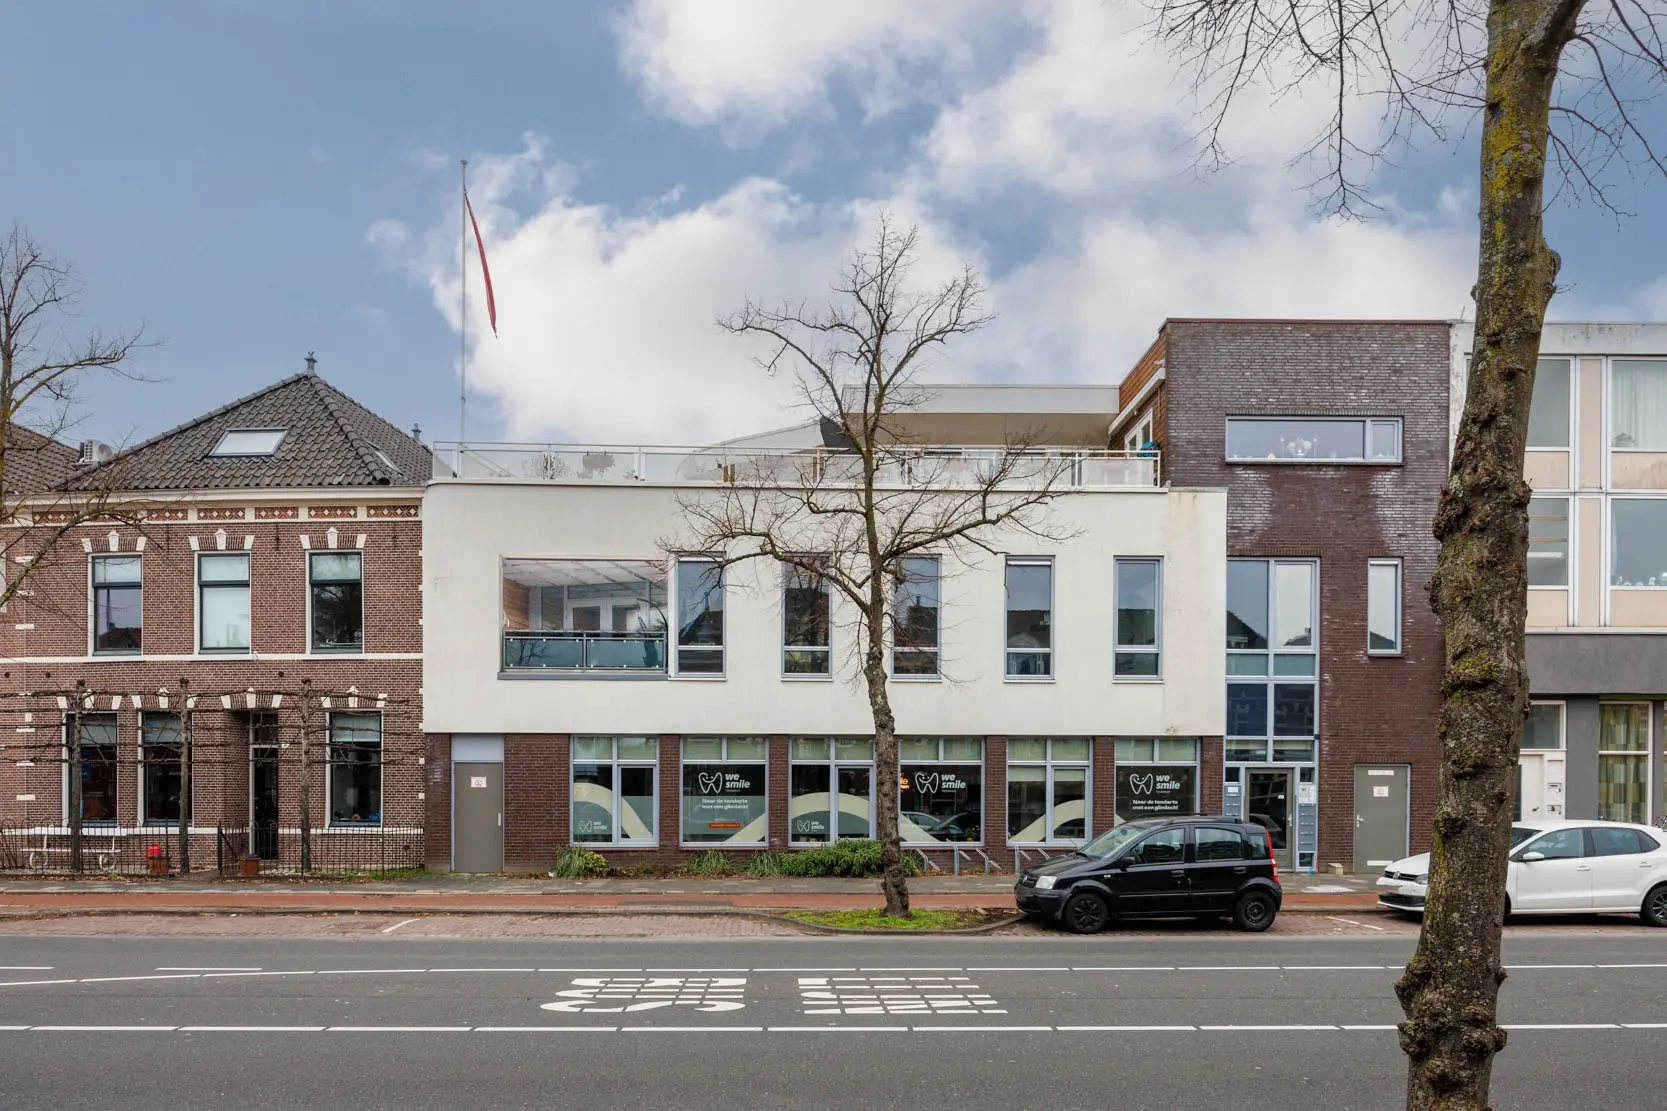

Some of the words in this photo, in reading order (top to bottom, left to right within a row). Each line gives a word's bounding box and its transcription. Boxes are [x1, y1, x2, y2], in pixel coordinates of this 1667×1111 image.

[725, 773, 740, 781] we
[1155, 774, 1170, 782] we
[725, 779, 751, 789] smile
[941, 780, 966, 789] smile
[1155, 780, 1181, 790] smile
[539, 977, 747, 1013] BUS
[796, 976, 1009, 1015] LIJN
